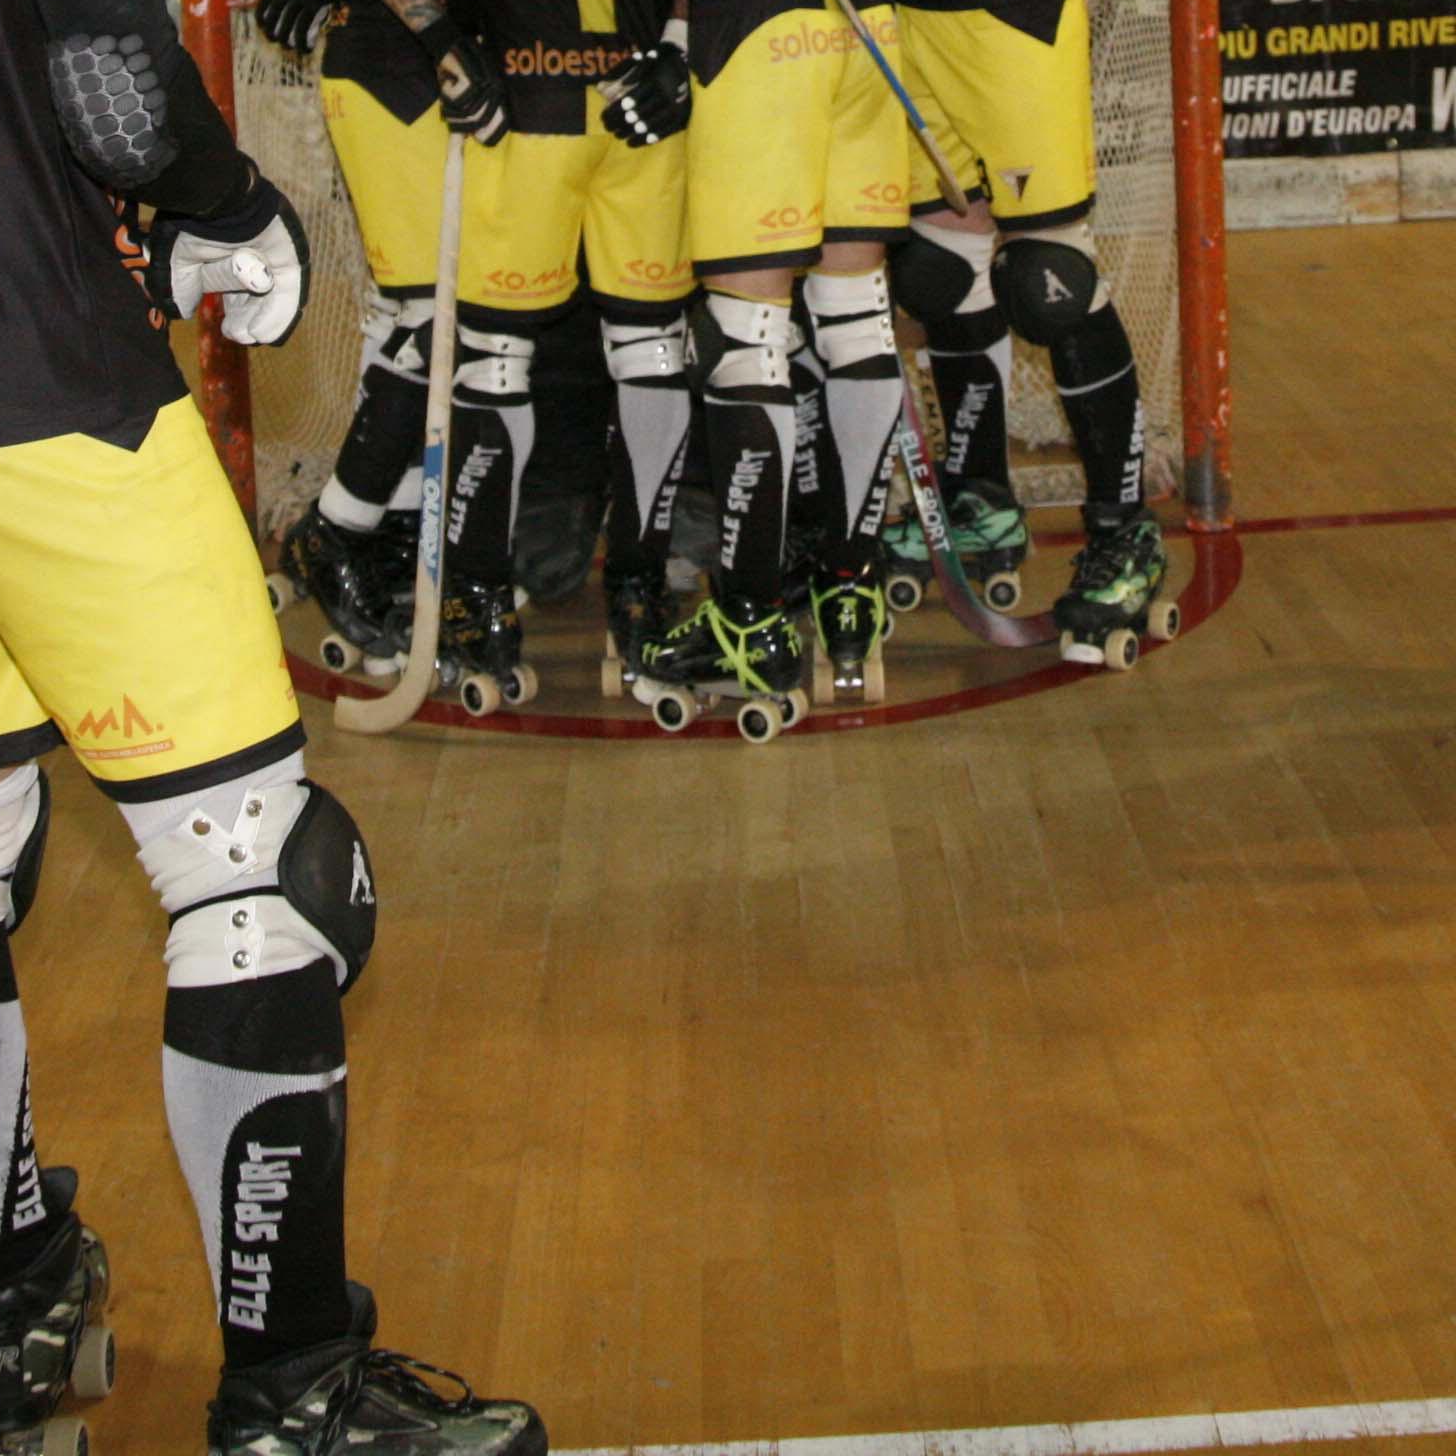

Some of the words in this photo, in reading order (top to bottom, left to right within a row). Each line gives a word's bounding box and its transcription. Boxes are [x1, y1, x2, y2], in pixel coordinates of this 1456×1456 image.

[1264, 20, 1382, 59] GRANDI
[1222, 67, 1359, 105] UFFICIALE
[1285, 102, 1418, 140] D'EUROPA
[455, 443, 504, 499] SPORT
[944, 430, 971, 475] ELLE
[726, 448, 773, 514] SPORT
[898, 429, 930, 482] ELLE
[917, 485, 952, 553] SPORT
[1119, 457, 1142, 505] ELLE
[446, 495, 469, 545] ELLE
[859, 485, 889, 537] ELLE
[720, 513, 741, 571] ELLE
[11, 1150, 48, 1232] ELLE
[232, 1141, 304, 1244] SPORT
[227, 1248, 273, 1333] ELLE
